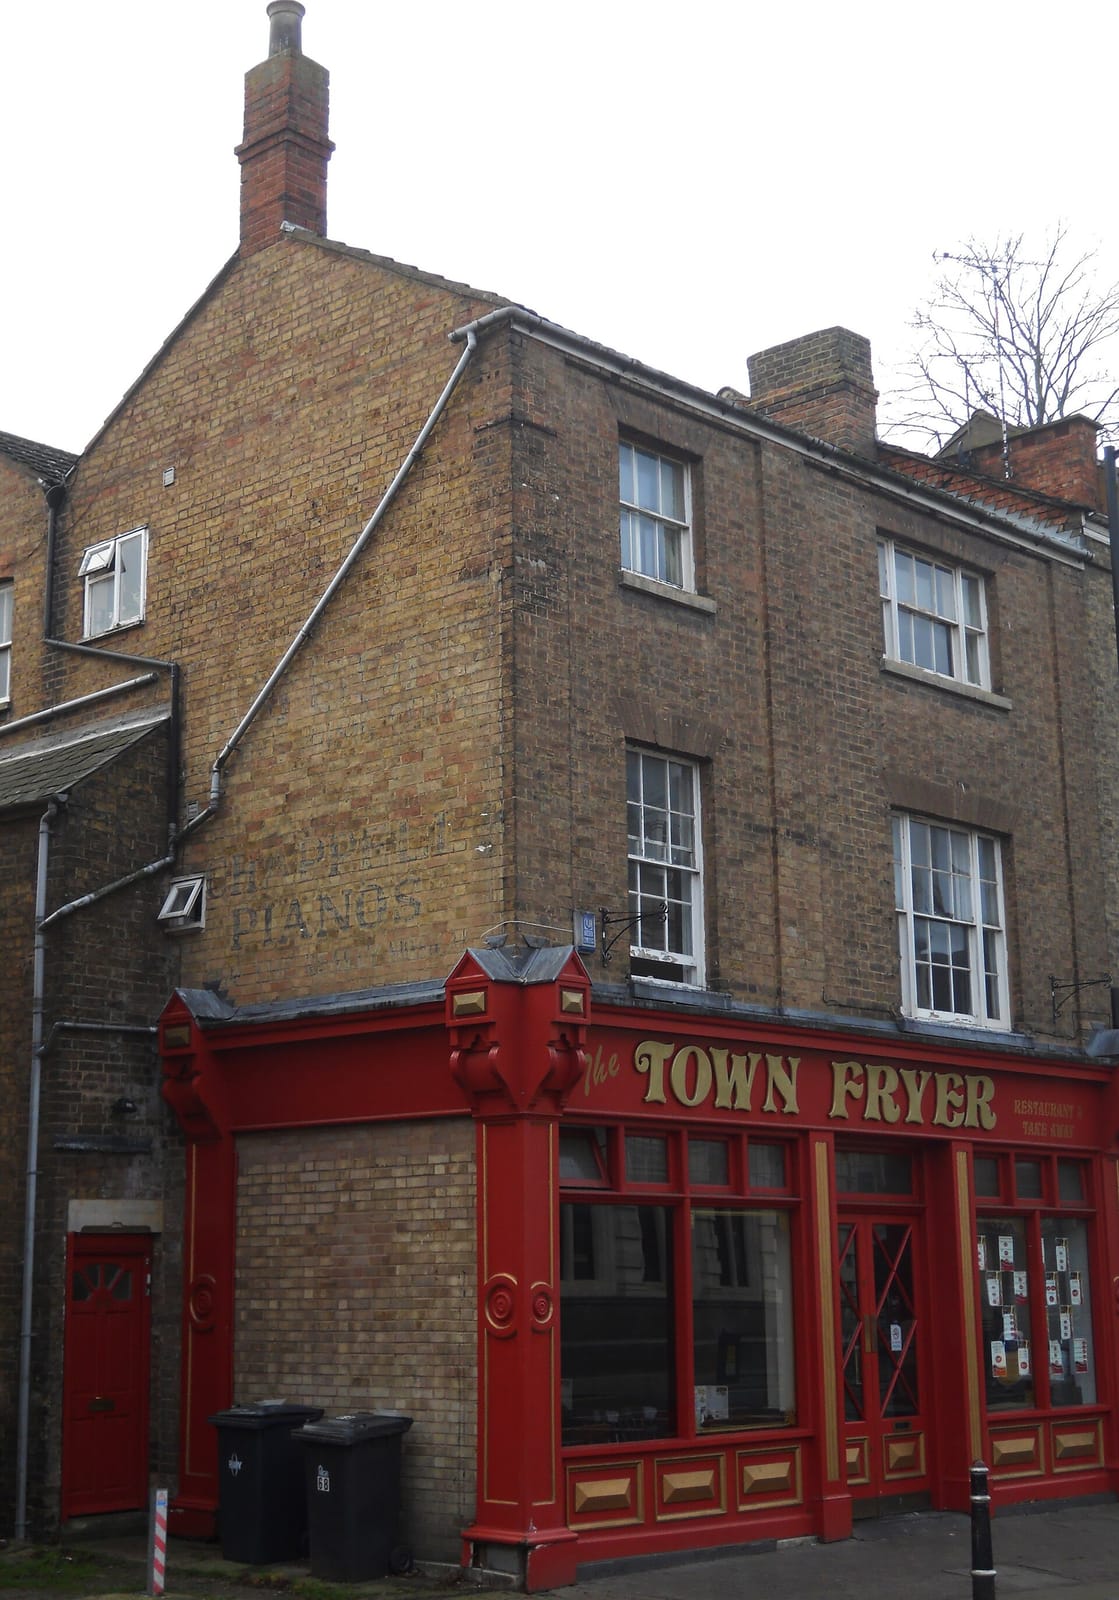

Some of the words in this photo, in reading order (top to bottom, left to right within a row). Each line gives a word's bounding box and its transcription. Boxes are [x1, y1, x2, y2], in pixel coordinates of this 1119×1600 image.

[231, 869, 422, 951] PIANOS
[584, 1044, 620, 1097] The
[634, 1040, 801, 1115] TOWN
[829, 1060, 997, 1131] FRYER
[1014, 1099, 1074, 1119] RESTAURANT
[1022, 1120, 1048, 1136] TAKE
[1050, 1123, 1074, 1138] AWAY
[318, 1477, 328, 1490] 68
